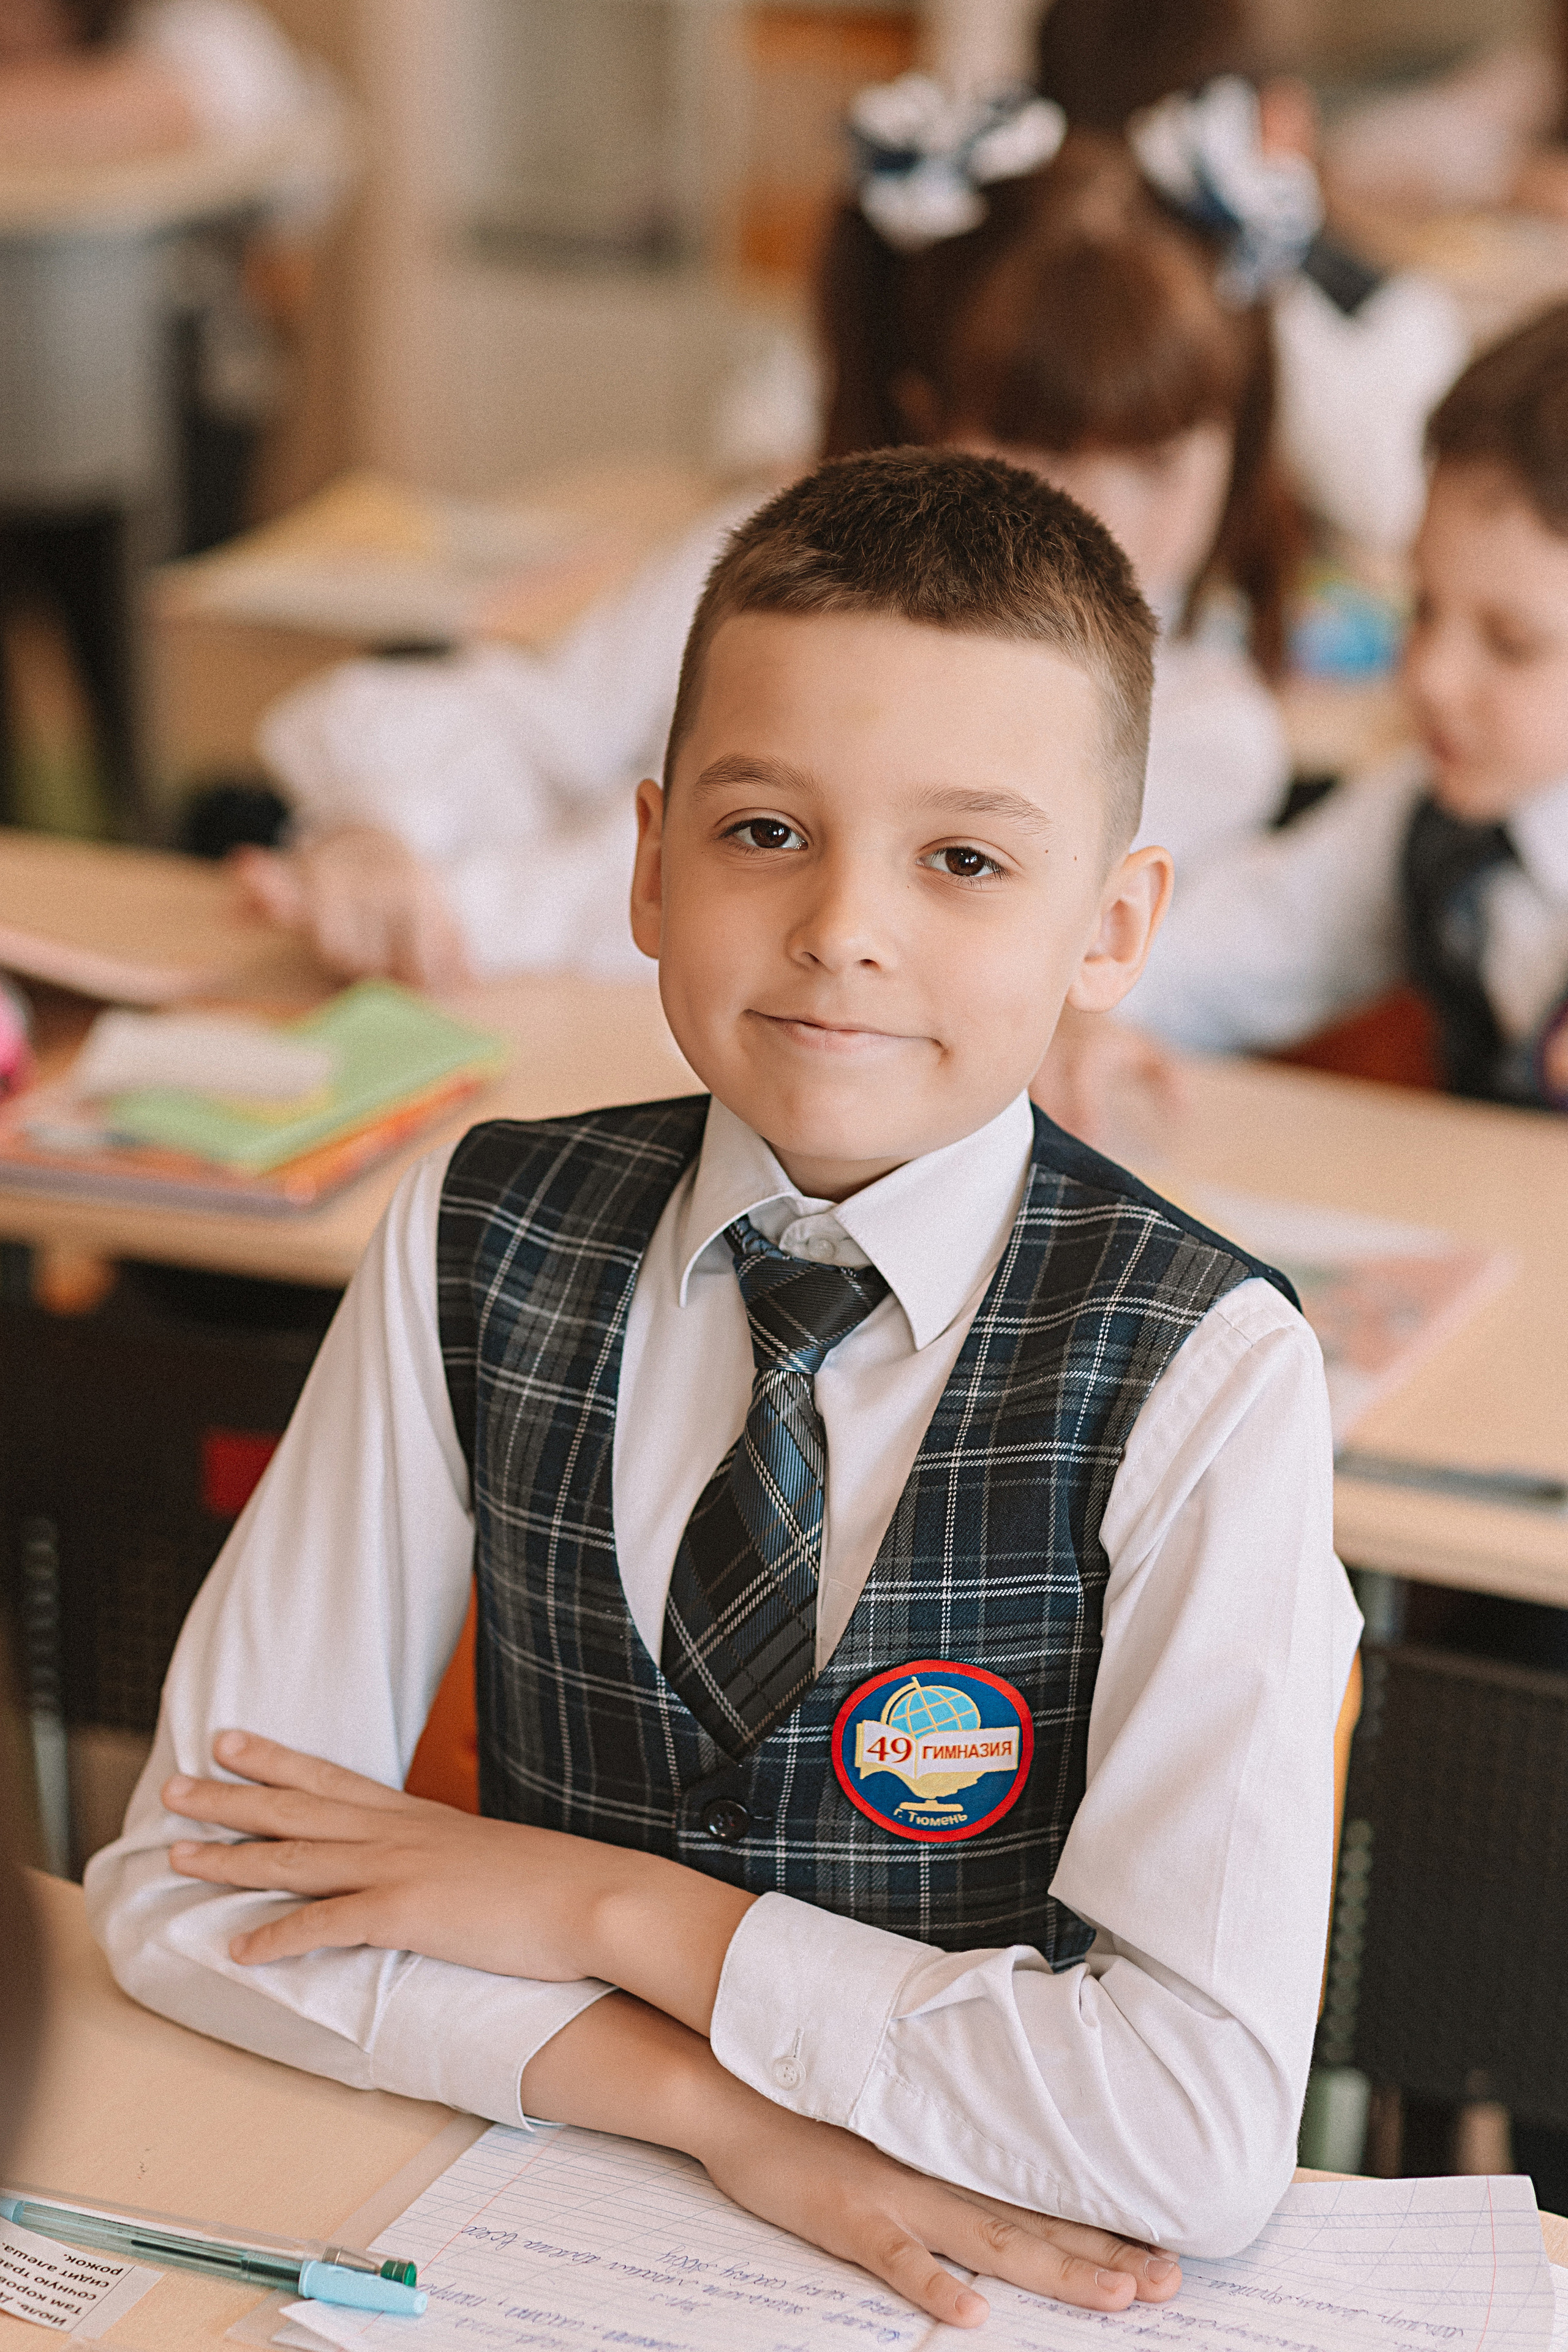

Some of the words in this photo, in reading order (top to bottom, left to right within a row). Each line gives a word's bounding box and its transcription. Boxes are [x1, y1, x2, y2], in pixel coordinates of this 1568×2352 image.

[865, 1736, 913, 1763] 49
[922, 1740, 1013, 1760] ГИМНАЗИЯ
[894, 1809, 903, 1819] г.
[909, 1811, 968, 1826] Тюмень
[0, 2259, 31, 2279] трав
[2, 2242, 58, 2272] алеша.
[62, 2253, 124, 2276] рожок.
[0, 2275, 48, 2302] коров
[33, 2275, 97, 2302] сочную
[60, 2269, 110, 2288] сидит
[17, 2301, 67, 2327] Июль.
[51, 2297, 83, 2316] Там
